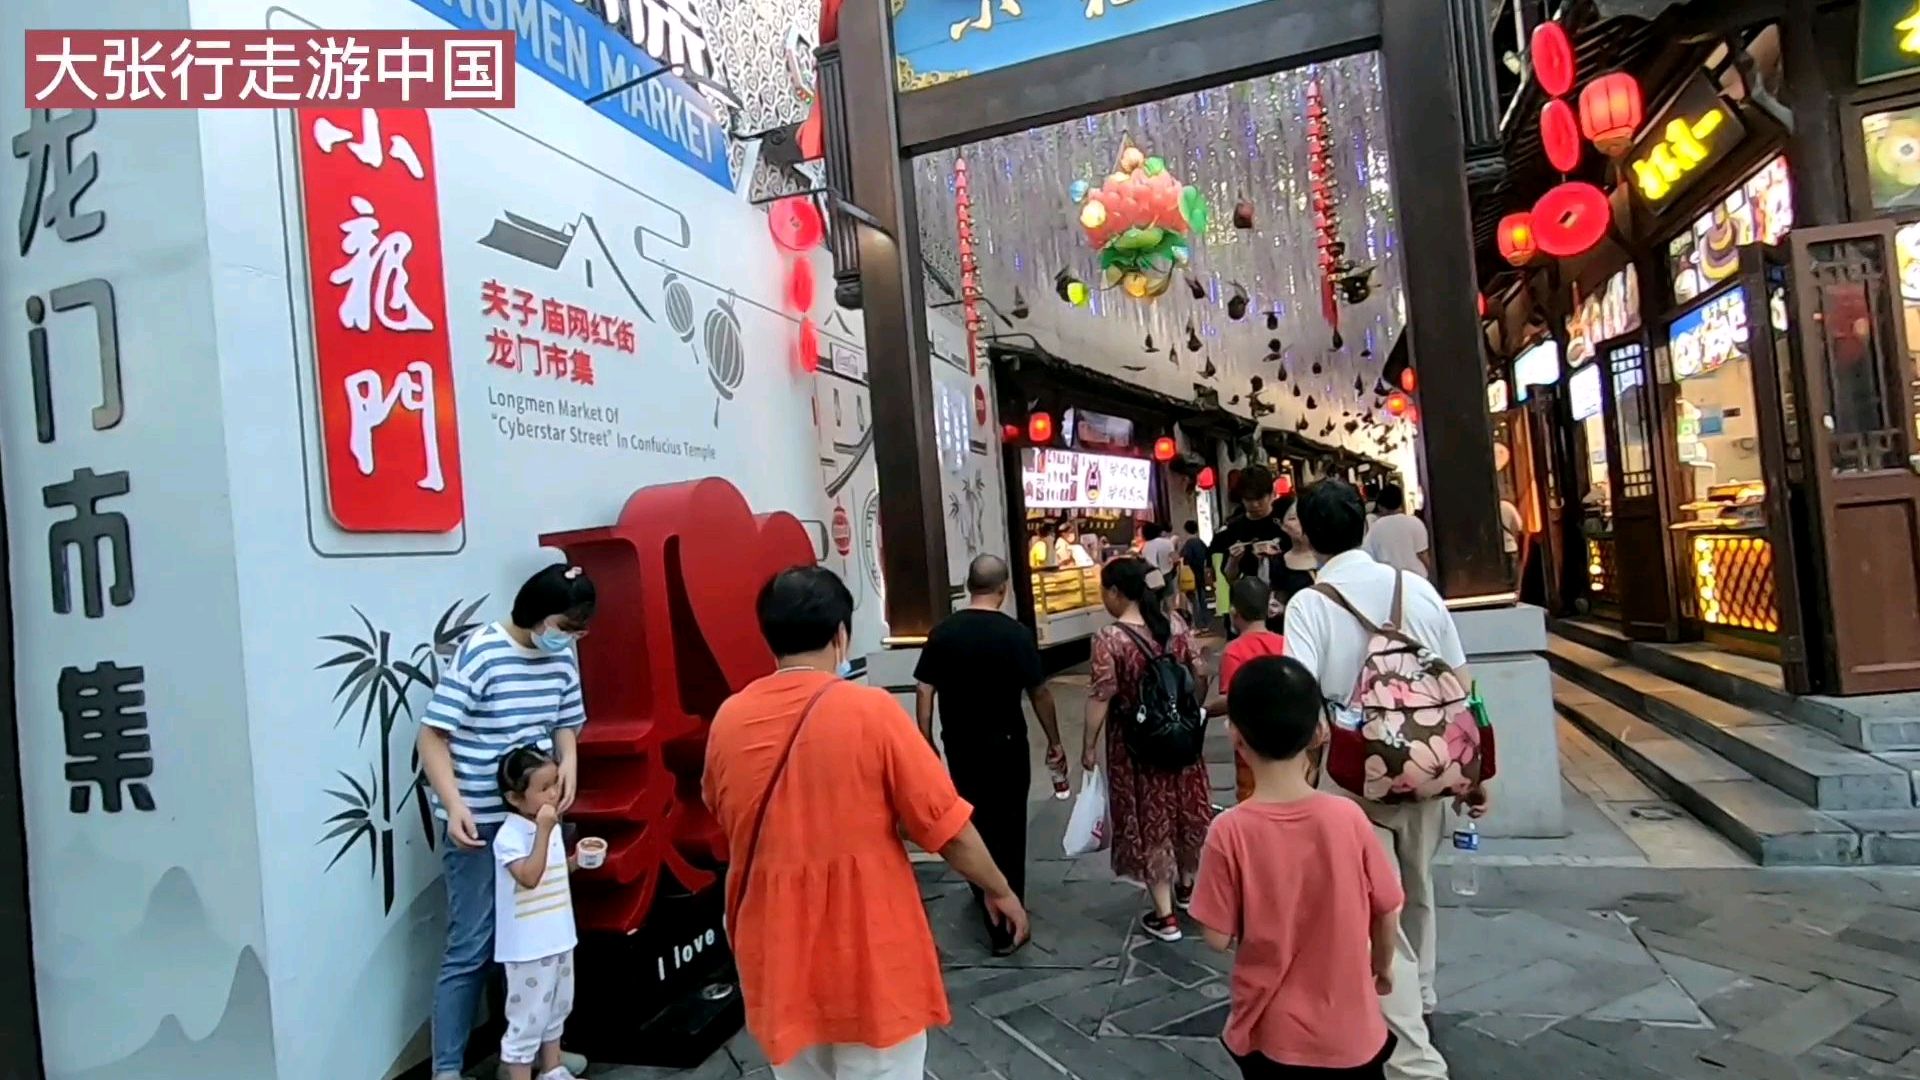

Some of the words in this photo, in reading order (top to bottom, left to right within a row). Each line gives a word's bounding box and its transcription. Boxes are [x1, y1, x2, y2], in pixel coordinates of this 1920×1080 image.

[444, 0, 591, 89] MEN
[599, 40, 713, 164] MARKET
[312, 108, 445, 493] 小龍門
[481, 279, 636, 354] 夫子庙网红街
[485, 327, 595, 386] 龙门市集
[488, 386, 555, 416] Longmen
[558, 399, 604, 422] Market
[605, 407, 620, 424] Of
[12, 108, 156, 814] 龙门市集
[616, 433, 629, 449] In
[630, 433, 682, 457] Confucius
[683, 441, 717, 462] Temple
[657, 956, 666, 981] I
[673, 928, 716, 969] love
